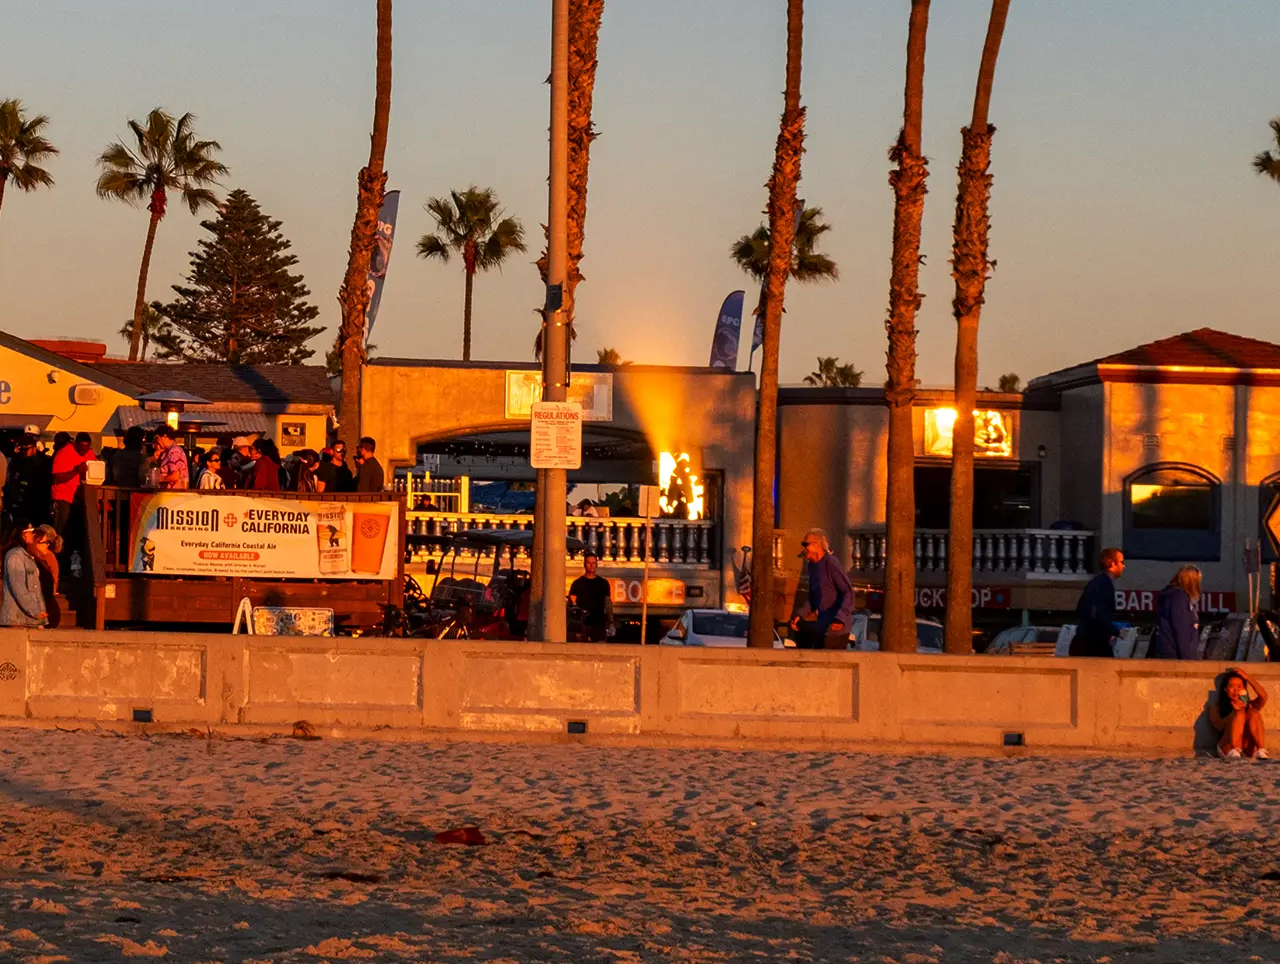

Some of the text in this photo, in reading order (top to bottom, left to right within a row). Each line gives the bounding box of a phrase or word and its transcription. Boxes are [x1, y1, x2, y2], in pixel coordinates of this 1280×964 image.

[534, 411, 579, 421] REGULATIONS
[156, 506, 219, 532] MISSION
[248, 509, 310, 522] EVERYDAY
[241, 521, 310, 534] CALIFORNIA
[181, 540, 209, 549] Everyday
[211, 541, 241, 549] California
[242, 542, 265, 550] Coastal
[204, 551, 255, 560] NOW AVAILABLE
[1114, 591, 1154, 611] BAR
